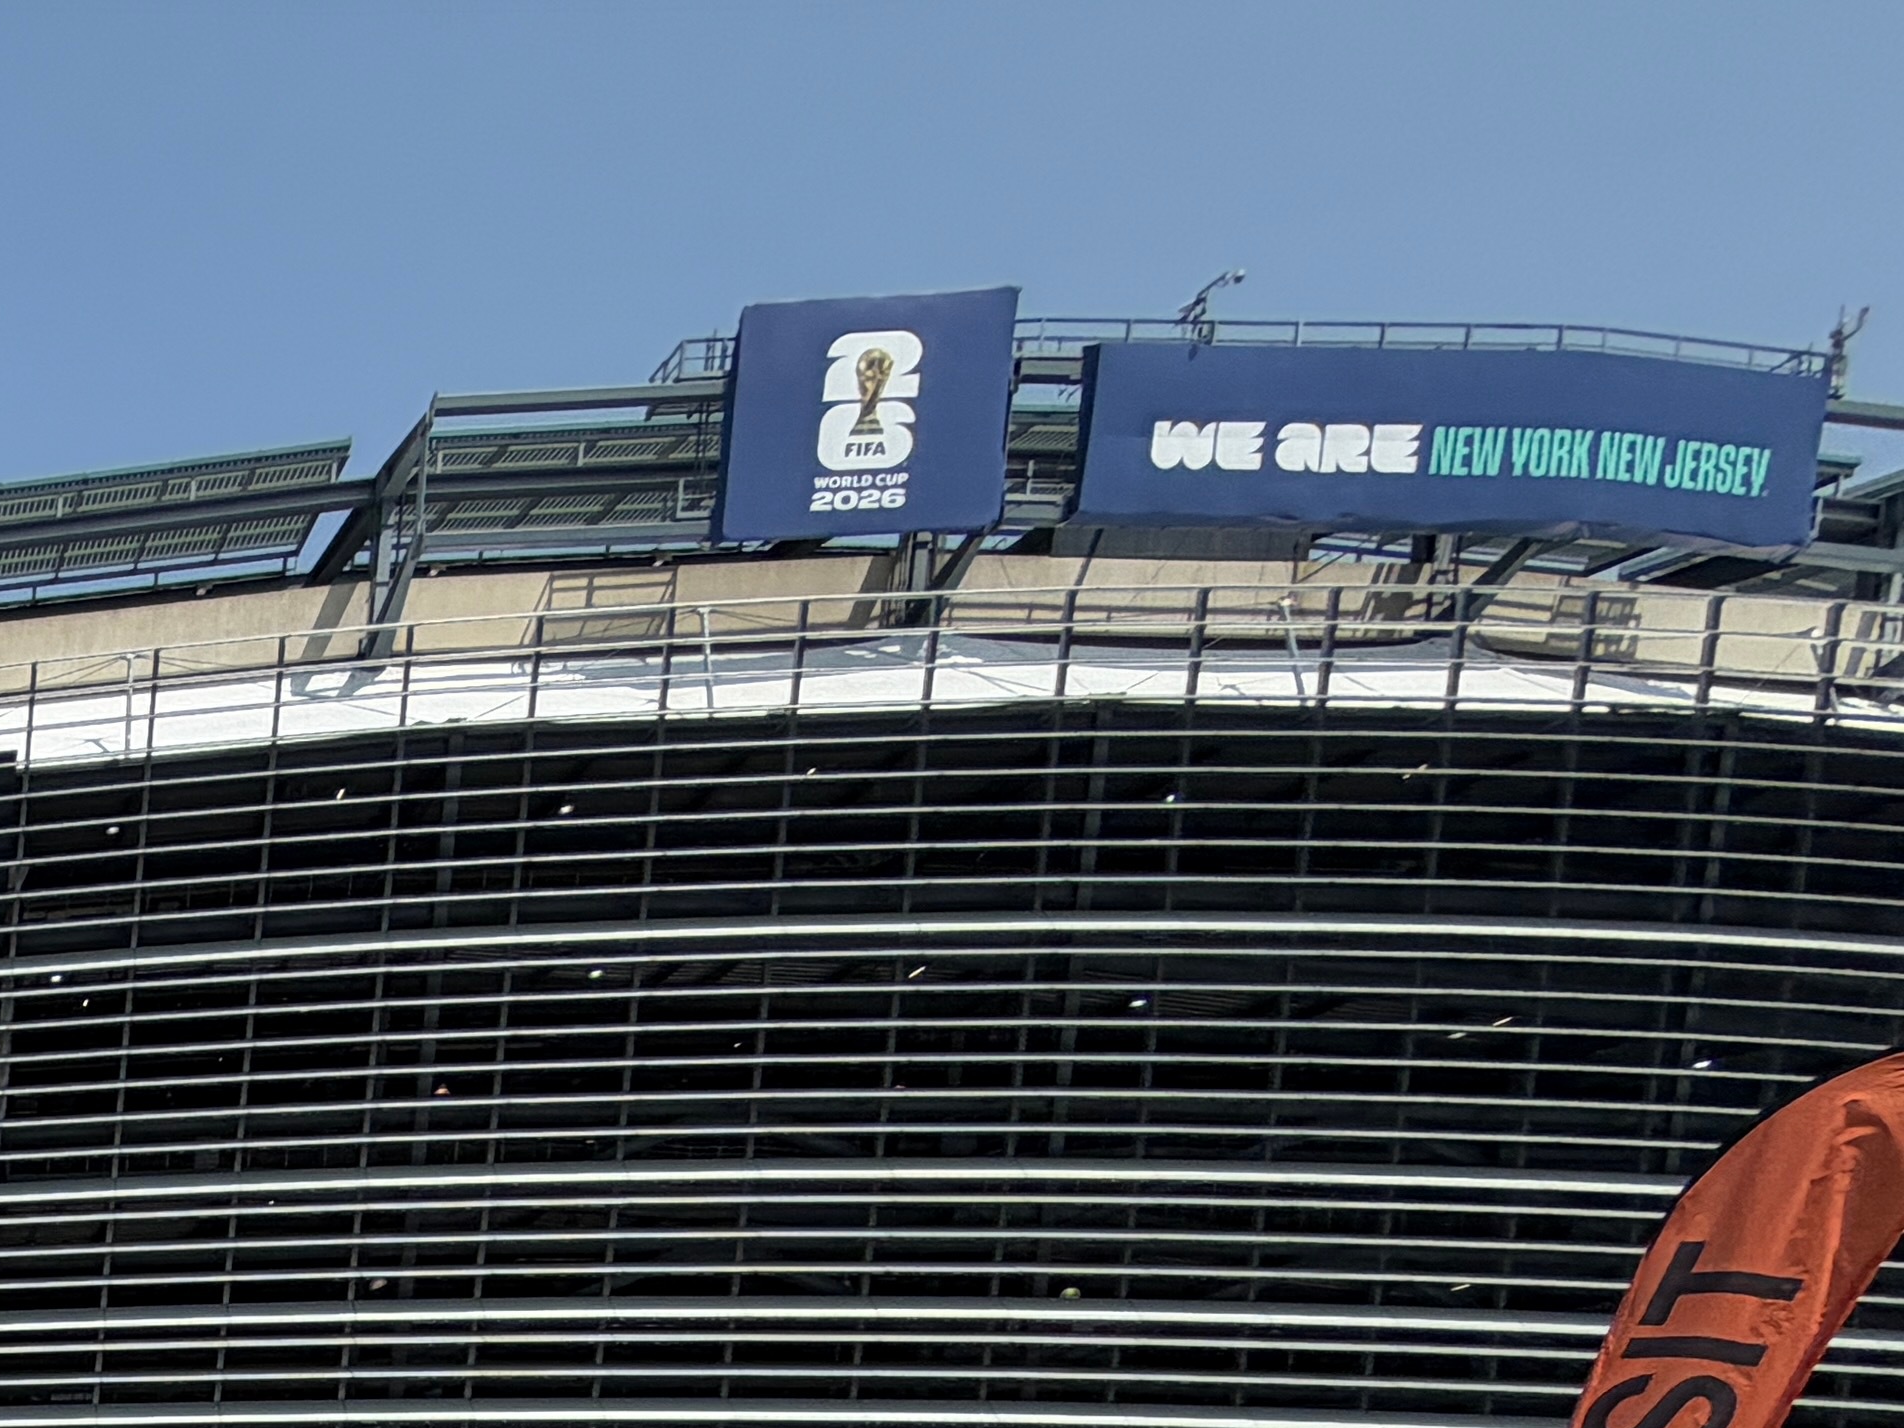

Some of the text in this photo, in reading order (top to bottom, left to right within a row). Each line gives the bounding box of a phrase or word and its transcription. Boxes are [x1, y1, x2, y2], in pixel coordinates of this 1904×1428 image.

[844, 441, 886, 458] FIFA
[1151, 420, 1267, 471] WE
[1428, 426, 1507, 476] NEW
[1512, 427, 1594, 479] YORK
[1595, 430, 1666, 485] NEW
[1664, 438, 1771, 497] JERSEY
[813, 472, 910, 489] WORLD CUP
[809, 488, 907, 512] 2026
